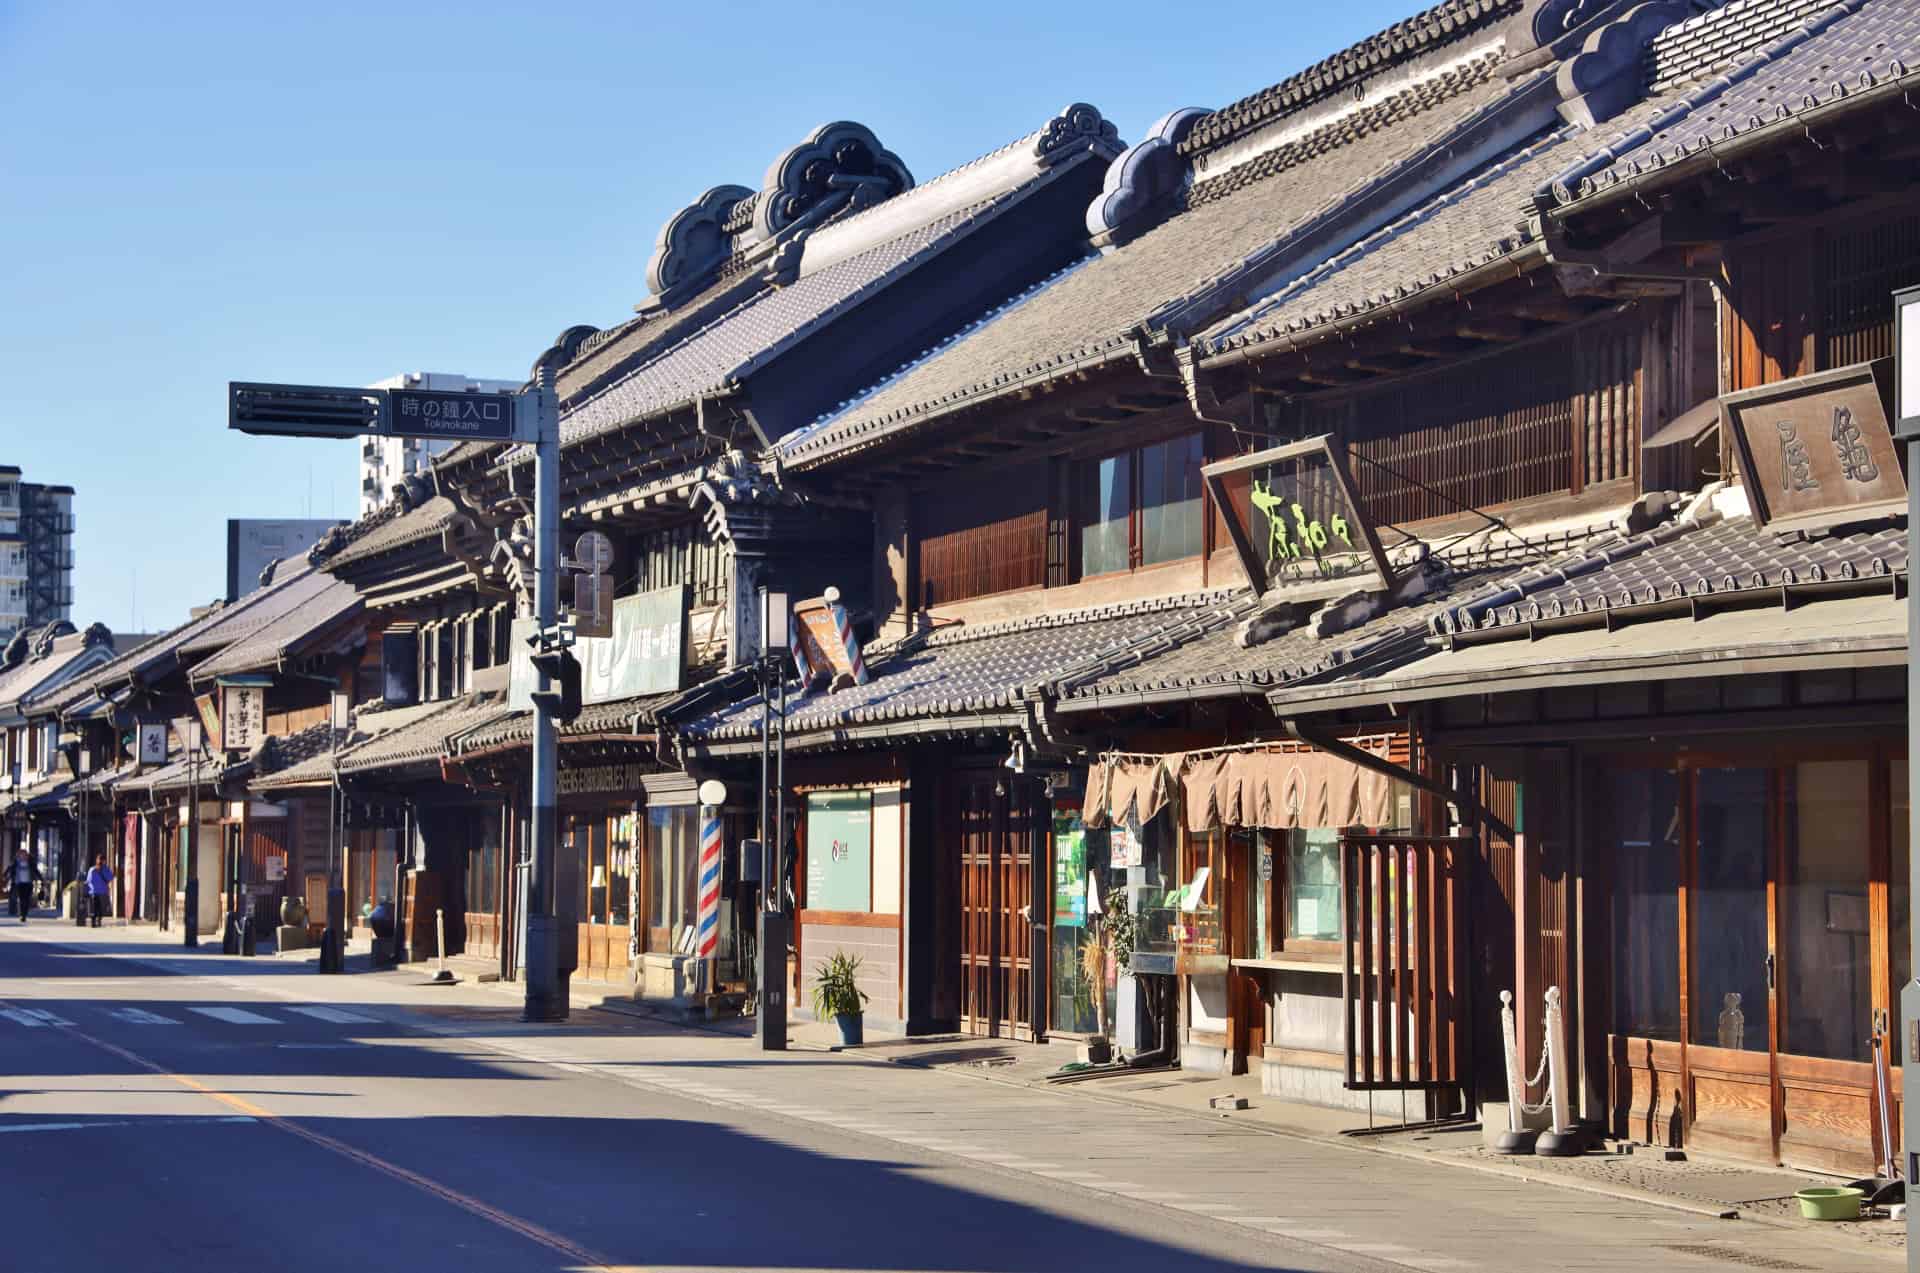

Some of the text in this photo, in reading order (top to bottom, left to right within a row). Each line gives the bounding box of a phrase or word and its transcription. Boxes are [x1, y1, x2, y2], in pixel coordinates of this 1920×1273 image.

[401, 398, 500, 420] 時の鐘入口
[424, 418, 480, 430] Tokinokane
